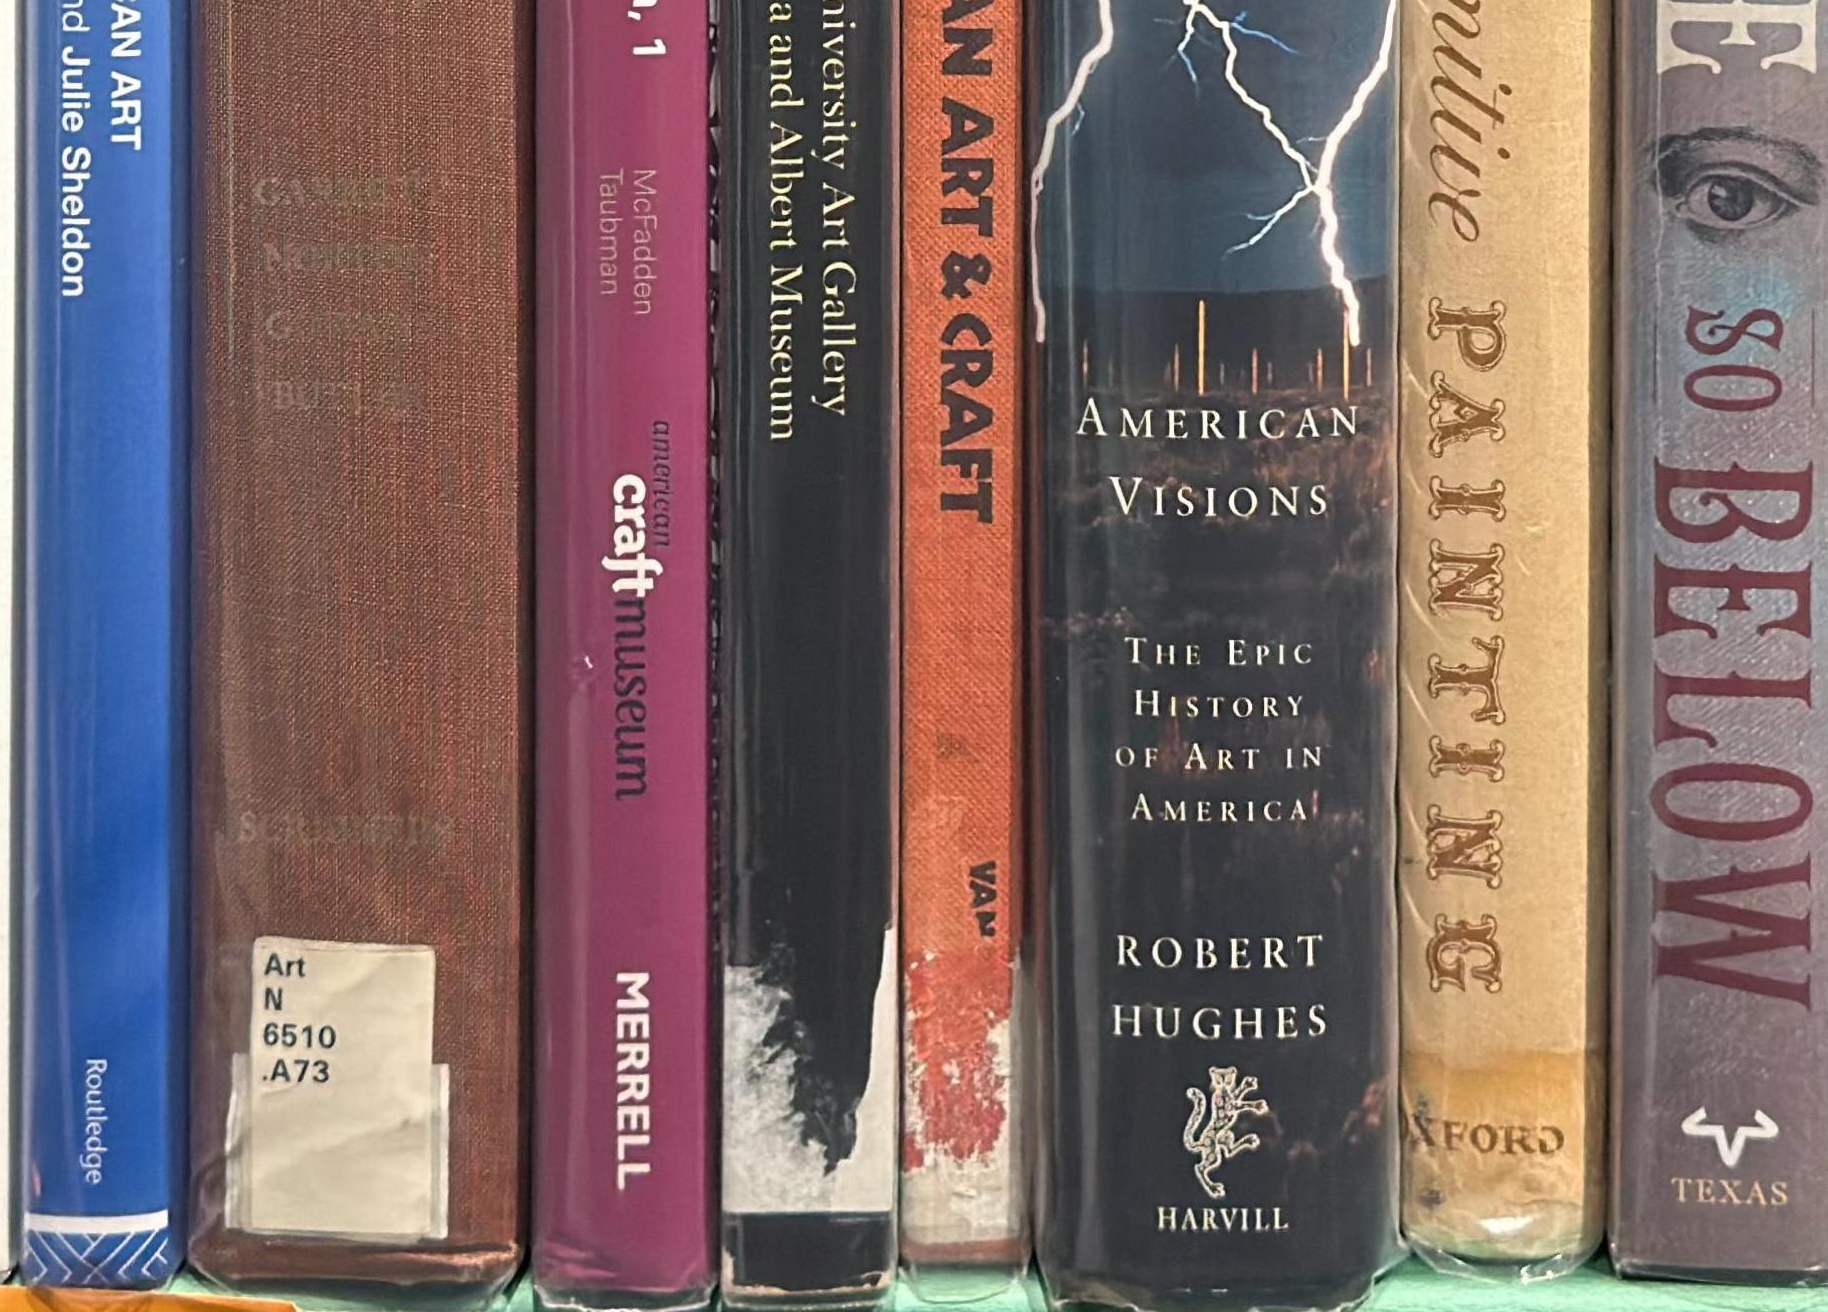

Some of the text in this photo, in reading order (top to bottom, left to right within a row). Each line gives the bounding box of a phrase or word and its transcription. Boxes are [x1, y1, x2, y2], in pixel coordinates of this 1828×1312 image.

[62, 46, 90, 132] Julie
[111, 71, 141, 150] ART
[62, 146, 91, 296] Sheldon
[770, 121, 804, 250] Albert
[823, 182, 855, 249] Art
[941, 96, 994, 237] ART
[600, 168, 623, 294] Taubman
[634, 170, 657, 314] McFadden
[770, 265, 802, 439] Museum
[811, 262, 856, 415] Gallery
[1684, 306, 1783, 412] SO
[940, 313, 993, 524] CRAFT
[1425, 297, 1506, 993] PAINTING
[1650, 452, 1817, 1011] BELOW
[264, 953, 305, 977] Art
[1118, 935, 1322, 969] ROBERT
[263, 1059, 329, 1083] .A73
[264, 1023, 336, 1049] 6510
[617, 973, 650, 1190] MERRELL
[1114, 1005, 1325, 1039] HUGHES
[80, 1059, 108, 1184] Routledge
[1158, 1207, 1288, 1231] HARVILL
[1671, 1178, 1788, 1206] TEXAS
